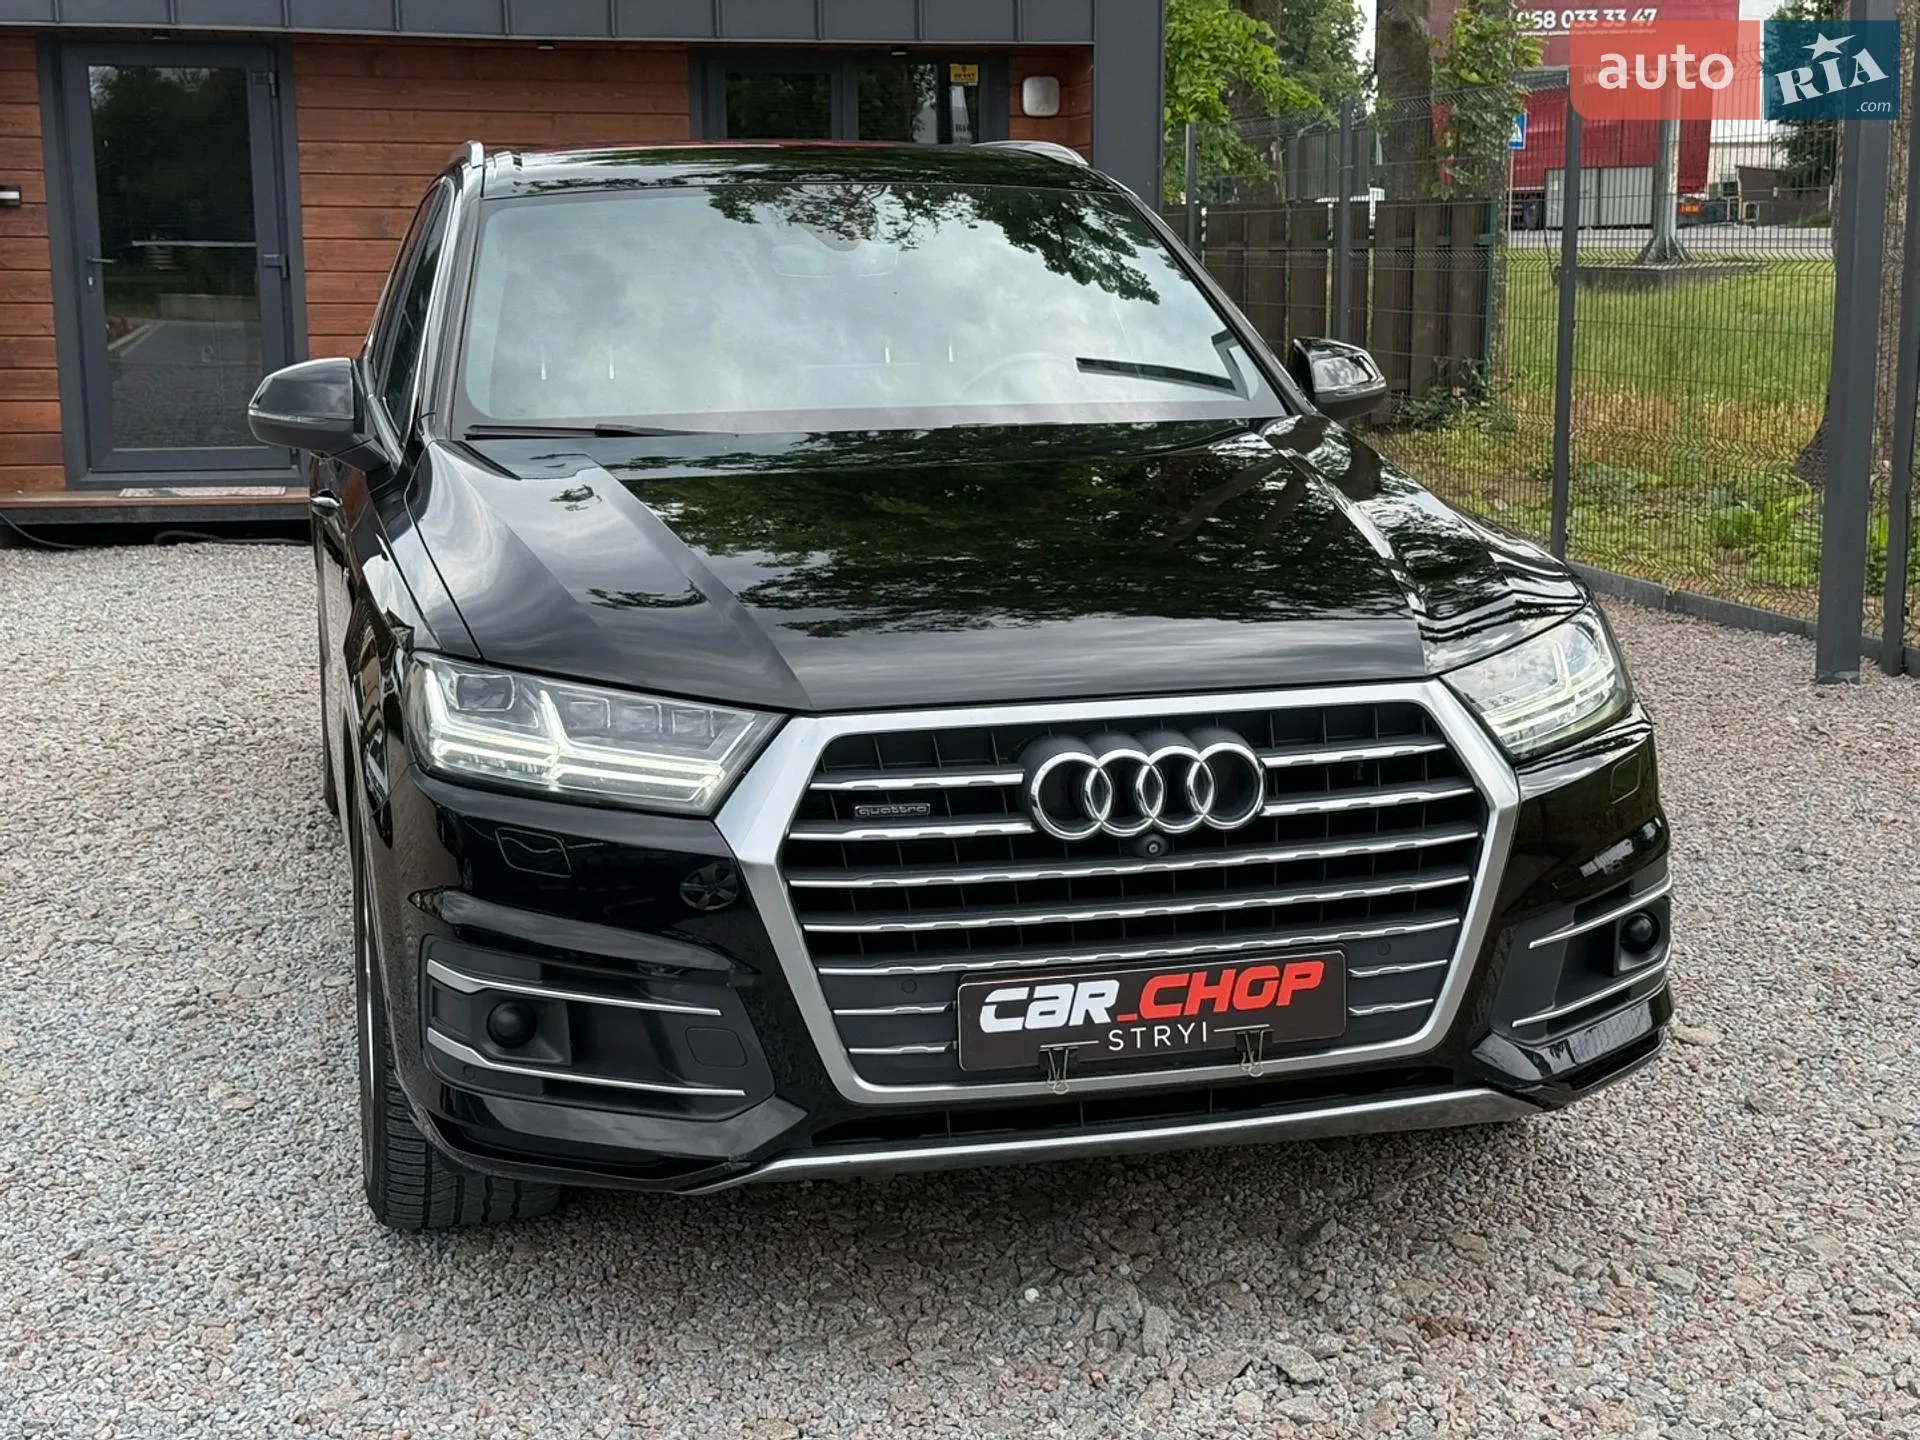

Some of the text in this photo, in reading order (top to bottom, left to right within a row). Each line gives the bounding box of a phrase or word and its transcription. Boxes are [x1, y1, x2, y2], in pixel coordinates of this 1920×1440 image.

[1561, 9, 1598, 29] 033
[1602, 8, 1627, 28] 33
[1631, 8, 1657, 28] 47
[858, 805, 928, 818] quattro
[1108, 1021, 1208, 1052] STRYI
